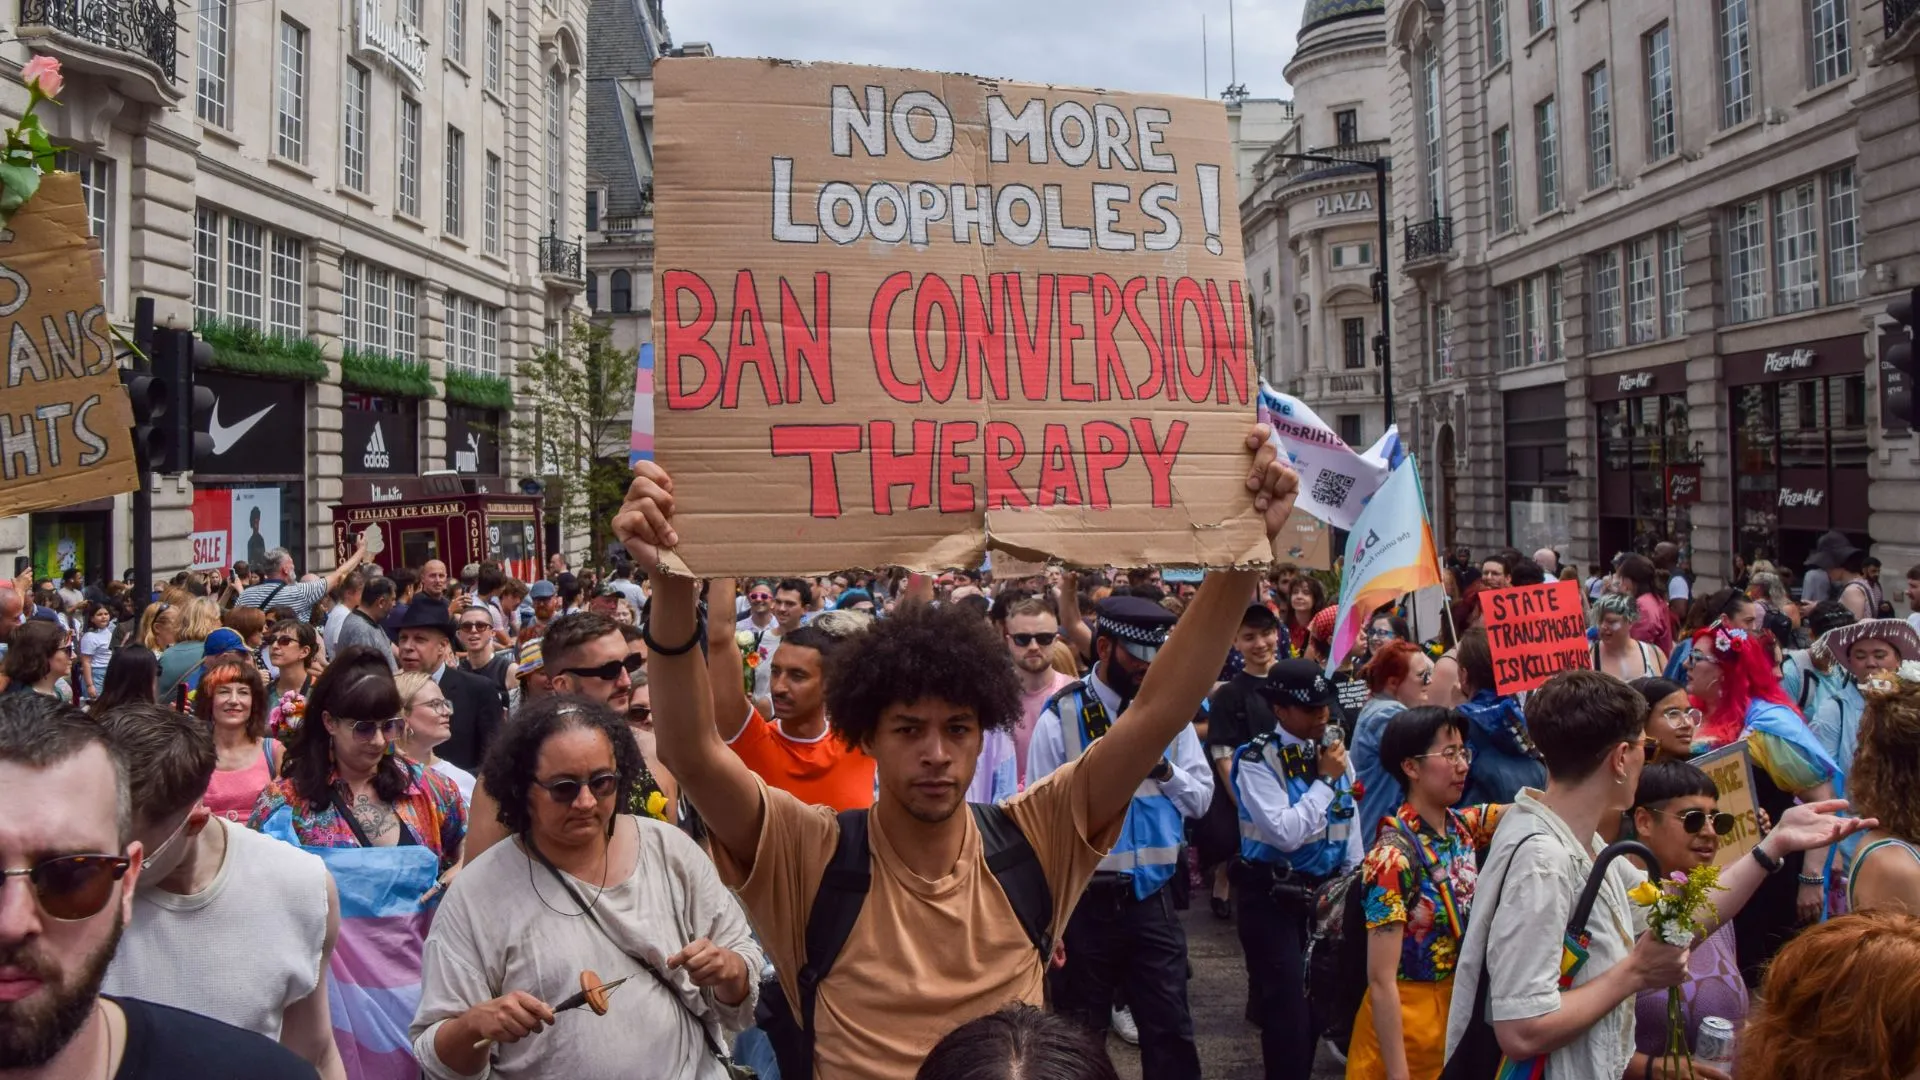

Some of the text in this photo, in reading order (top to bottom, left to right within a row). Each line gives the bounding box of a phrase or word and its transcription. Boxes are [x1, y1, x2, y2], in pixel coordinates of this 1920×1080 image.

[831, 85, 1177, 173] NO MORE
[1316, 191, 1372, 216] PLAZA
[0, 304, 113, 388] ANS
[661, 270, 1251, 411] BAN CONVERSION
[364, 452, 389, 468] adidas
[456, 451, 478, 472] PUMA
[771, 418, 1188, 518] THERAPY
[354, 504, 458, 519] ITALIAN ICE CREAM
[193, 537, 221, 565] SALE
[471, 517, 479, 557] SOFT
[1493, 588, 1559, 620] STATE
[1488, 614, 1586, 648] TRANSPHOBIA
